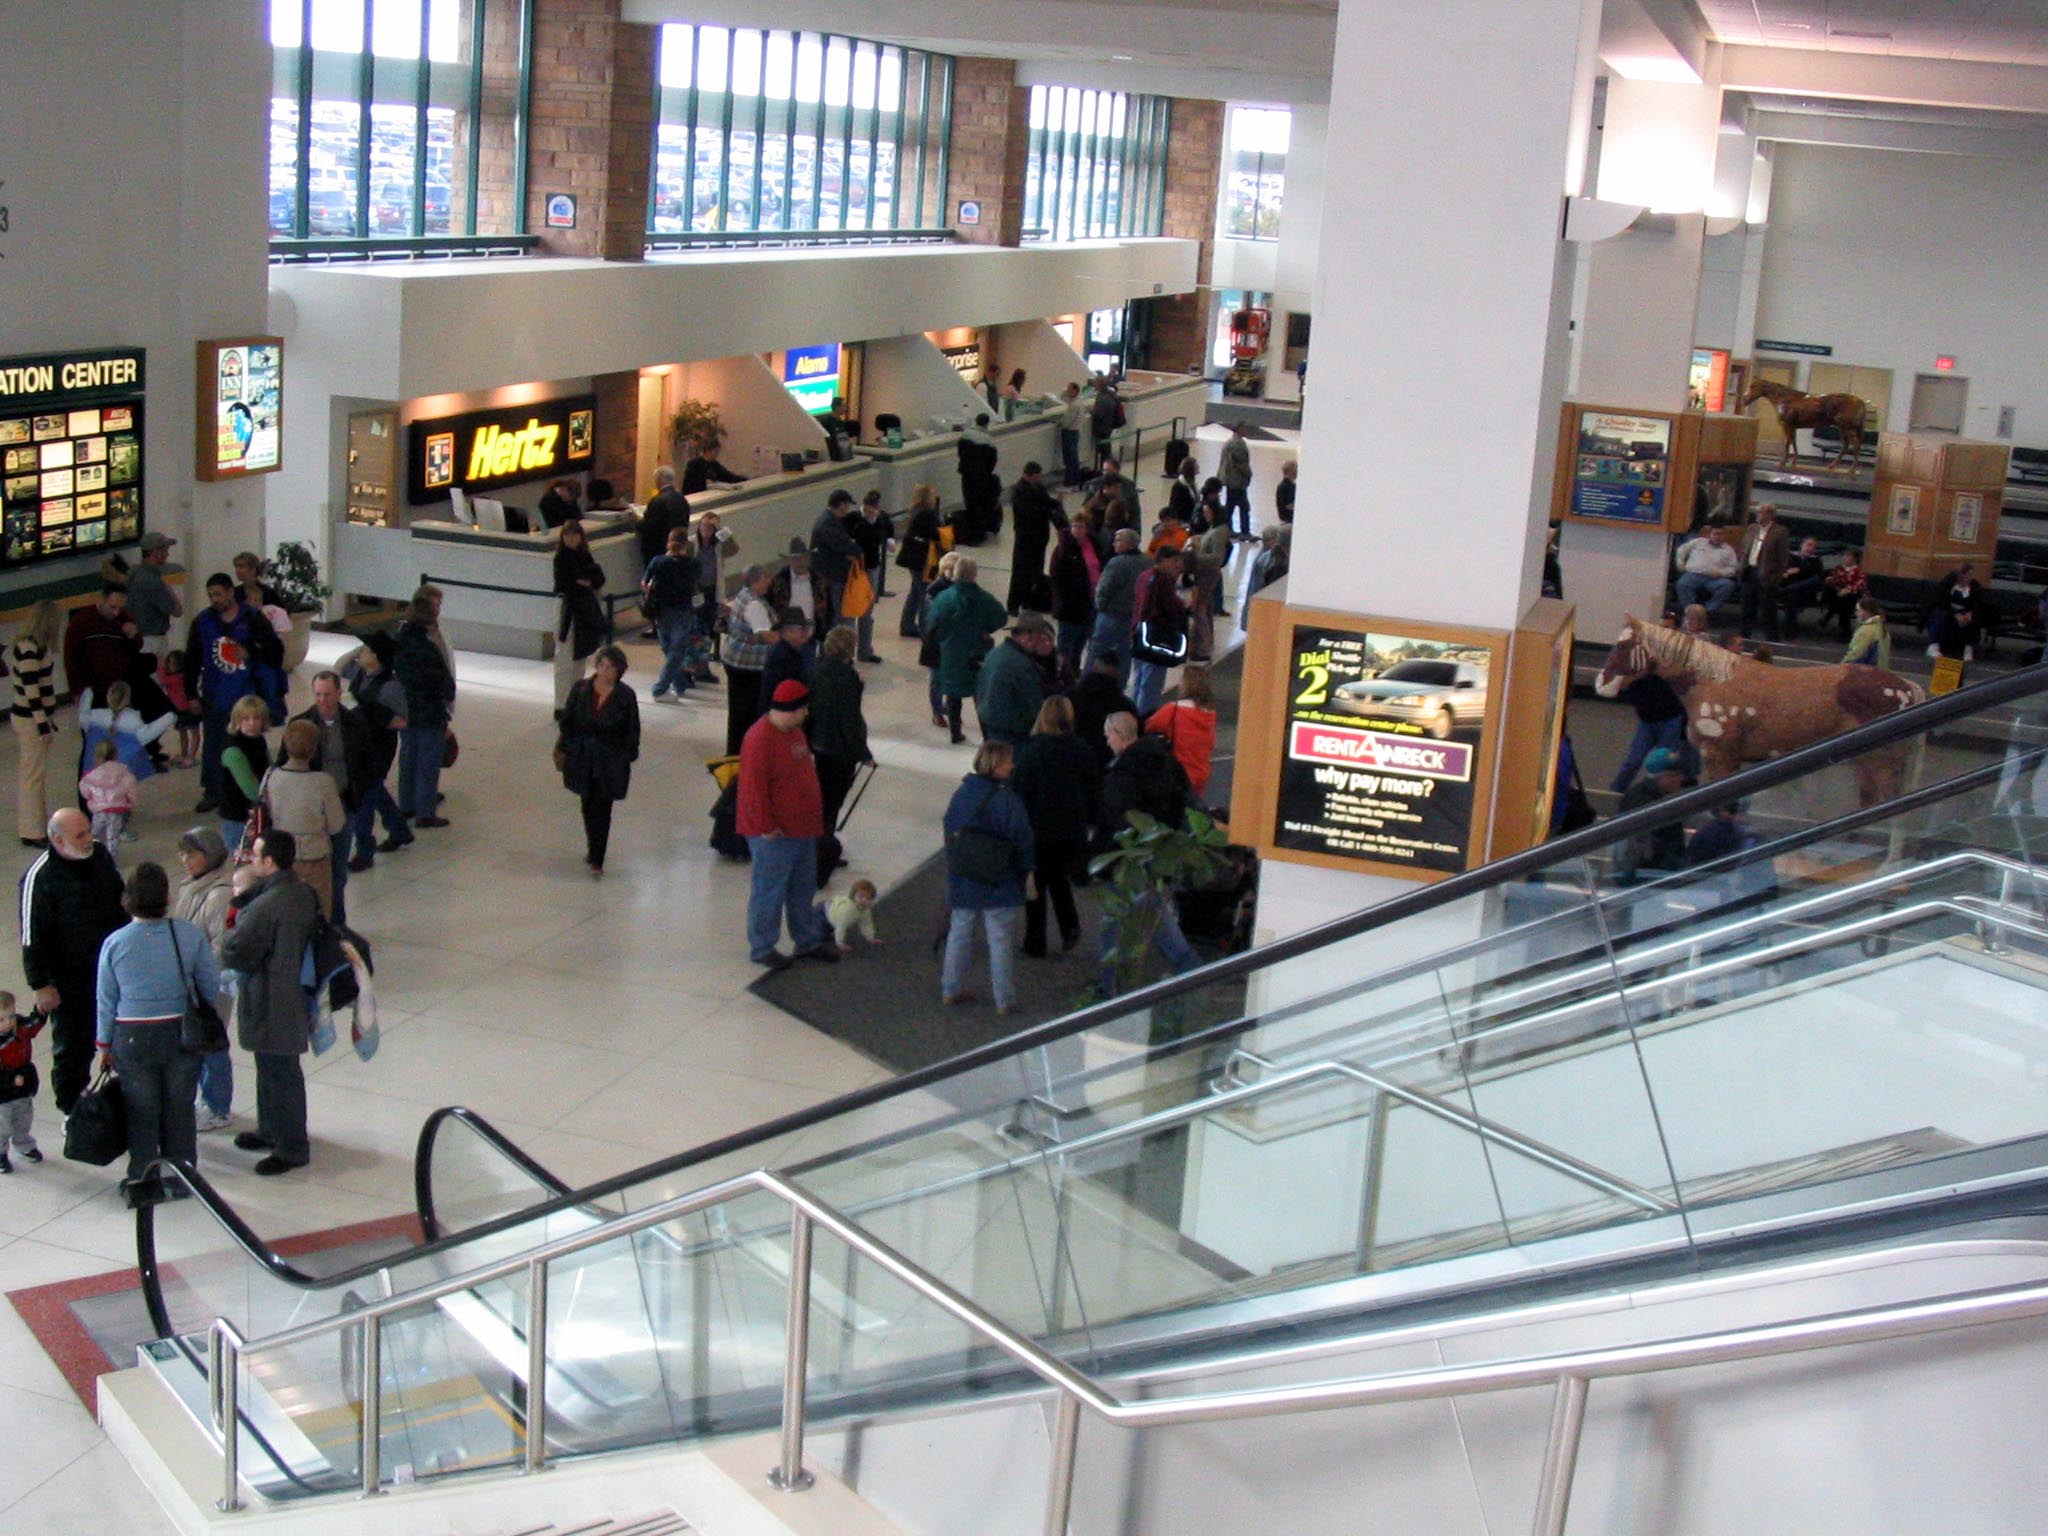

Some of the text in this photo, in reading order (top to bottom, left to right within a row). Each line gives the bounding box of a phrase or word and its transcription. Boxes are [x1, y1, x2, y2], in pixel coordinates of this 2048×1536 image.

[62, 358, 137, 389] CENTER
[795, 355, 829, 375] Alamo
[465, 418, 560, 481] Hertz
[1299, 649, 1331, 667] Dial
[1295, 665, 1329, 704] 2
[1323, 713, 1370, 727] reservation
[1314, 766, 1435, 797] why pay more?
